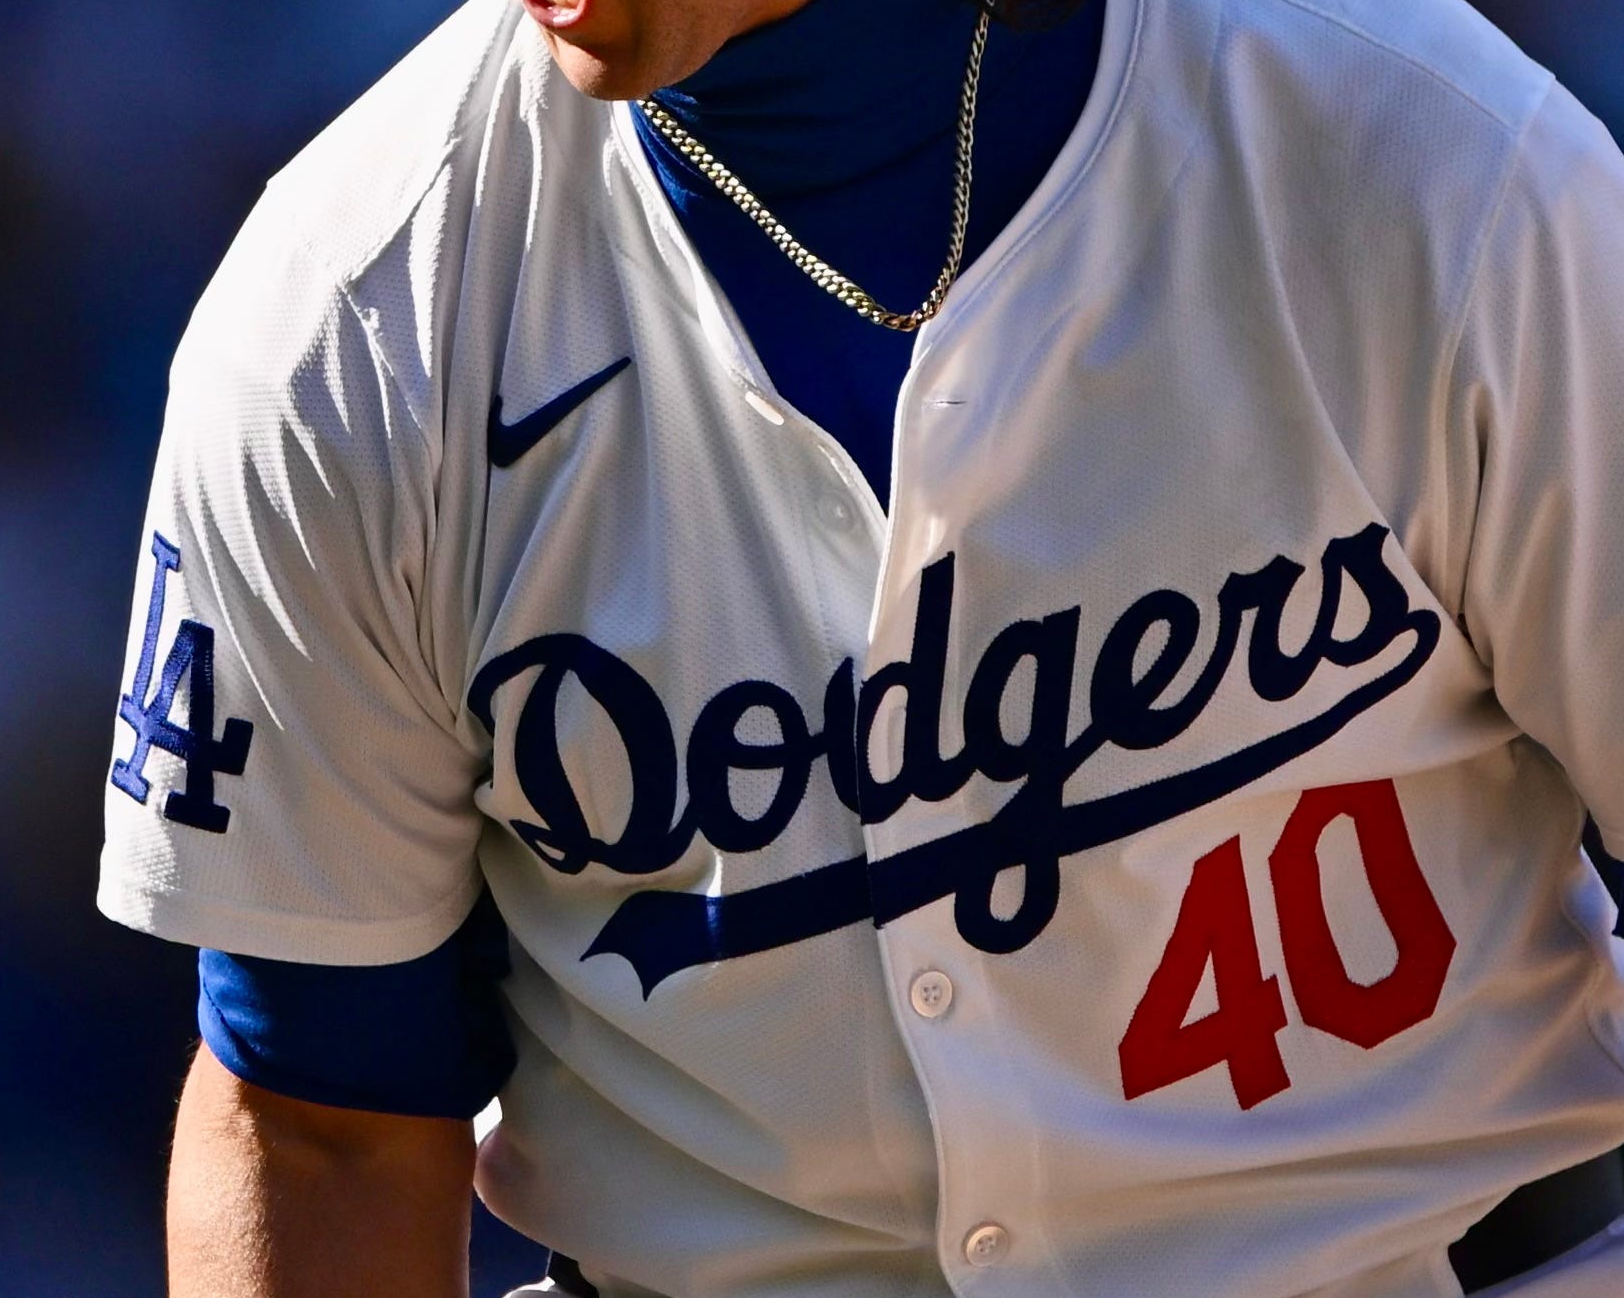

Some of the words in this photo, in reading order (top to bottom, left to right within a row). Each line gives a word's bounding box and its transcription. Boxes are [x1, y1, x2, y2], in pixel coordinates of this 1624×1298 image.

[110, 530, 253, 834] LA
[466, 521, 1442, 955] Dodgers
[1118, 778, 1457, 1111] 40
